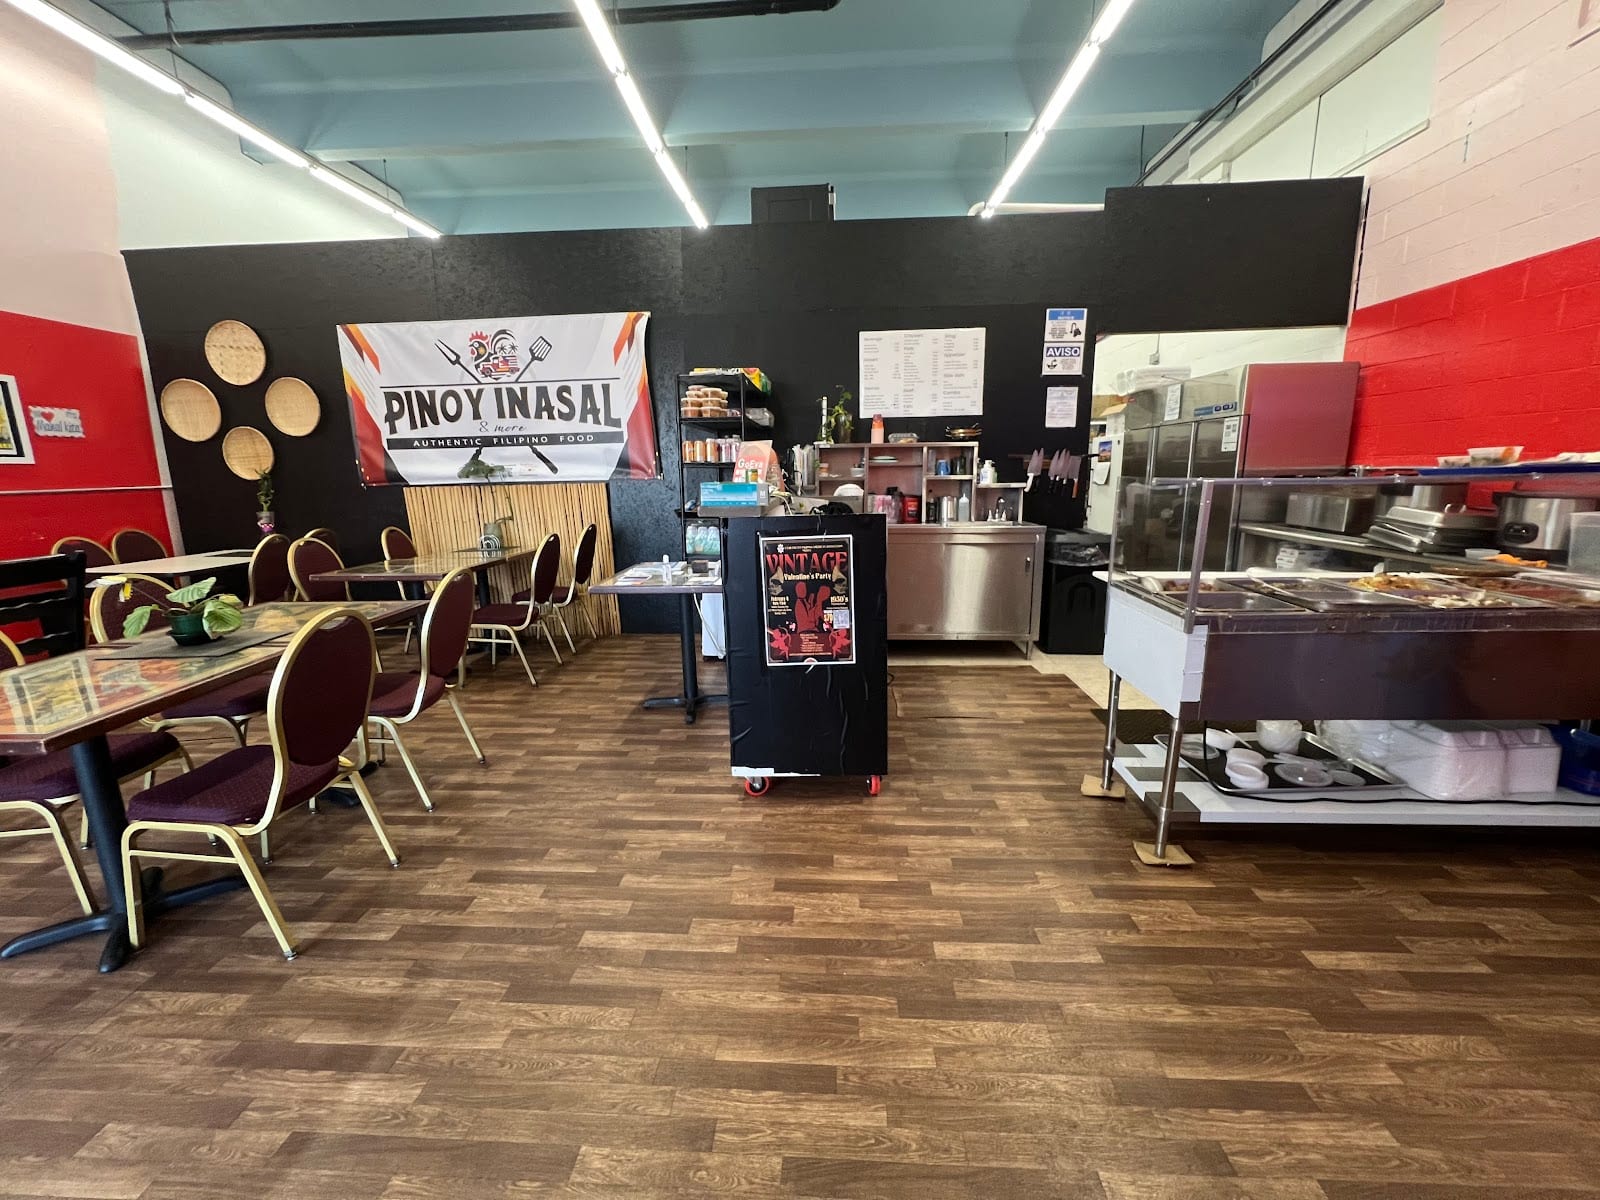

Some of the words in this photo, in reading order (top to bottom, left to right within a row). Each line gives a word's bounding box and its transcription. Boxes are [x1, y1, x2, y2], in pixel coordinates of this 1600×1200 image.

[1047, 347, 1080, 357] AVISO
[383, 388, 485, 435] PINOY
[494, 383, 622, 429] INASAL
[479, 421, 490, 432] &
[494, 424, 526, 433] more
[413, 438, 482, 448] AUTHENTIC
[493, 436, 549, 445] FILIPINO
[559, 434, 595, 443] FOOD
[766, 551, 848, 574] VINTAGE
[784, 573, 815, 581] Valentine's
[815, 572, 832, 581] Party
